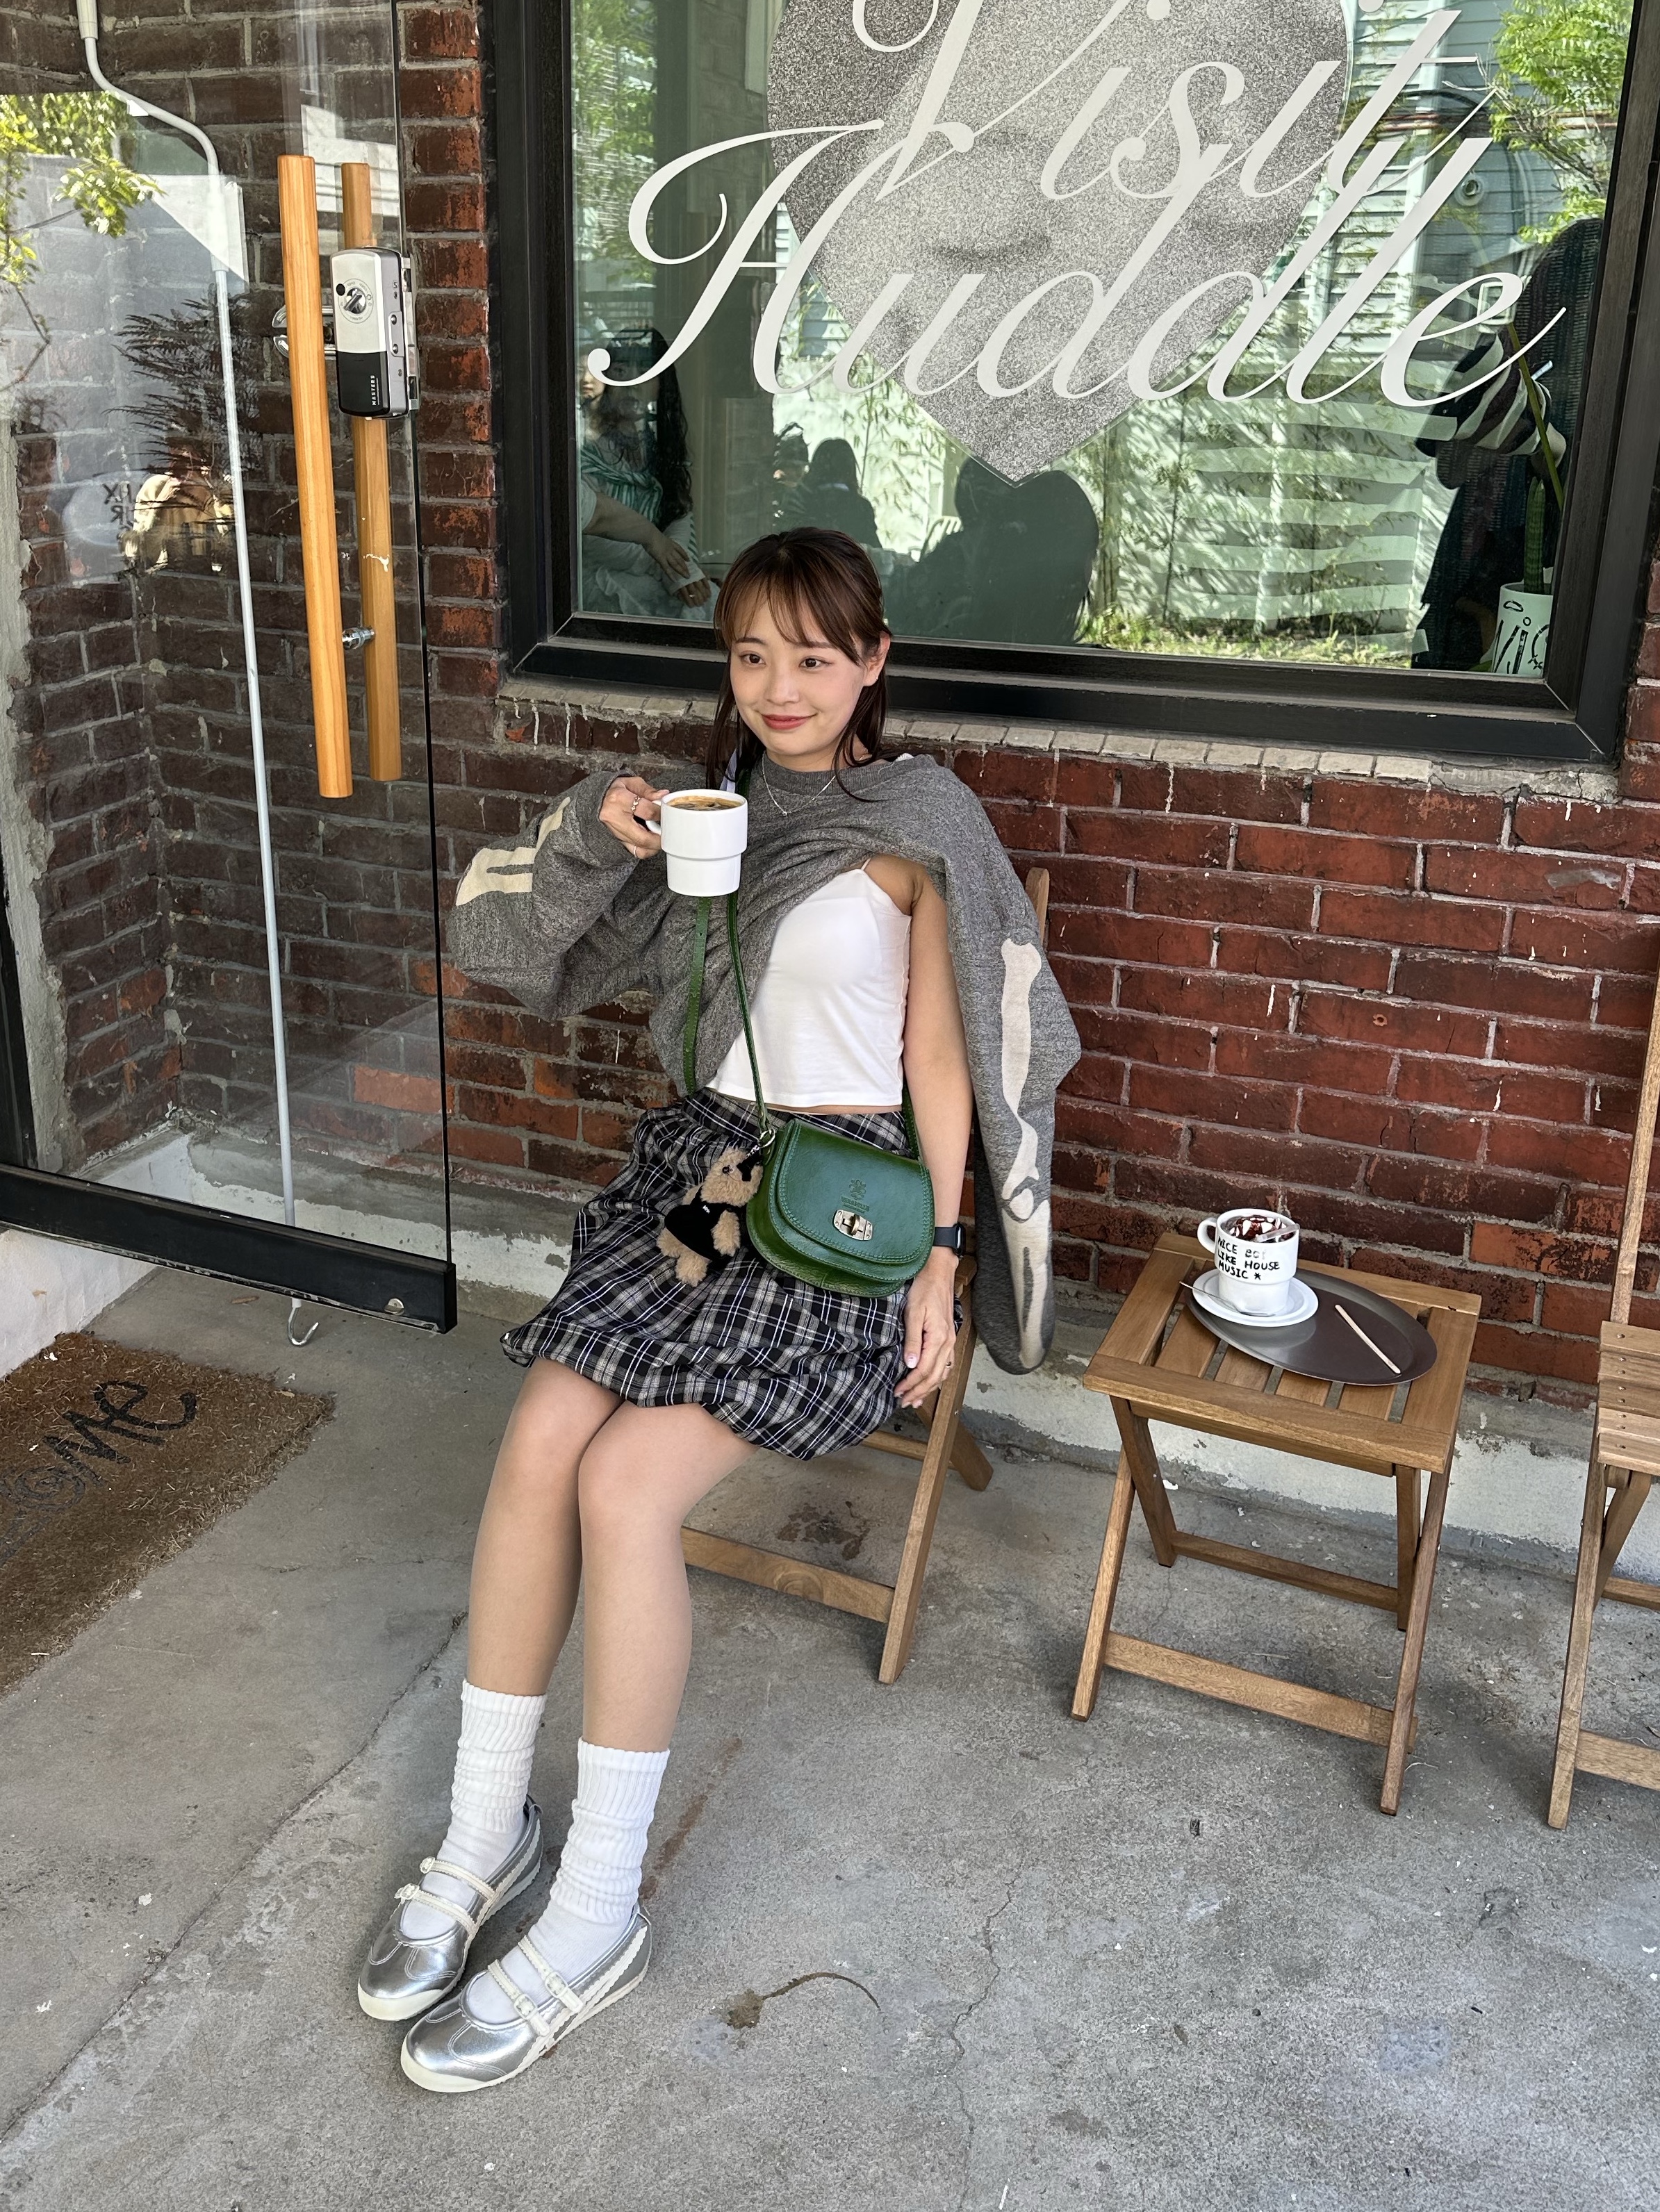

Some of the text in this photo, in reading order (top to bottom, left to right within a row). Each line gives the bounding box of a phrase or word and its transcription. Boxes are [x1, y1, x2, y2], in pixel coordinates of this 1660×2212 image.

[587, 119, 1567, 406] Huddle
[1217, 1236, 1238, 1254] NICE
[1217, 1248, 1280, 1271] LIKE HOUSE
[1218, 1260, 1249, 1279] MUSIC
